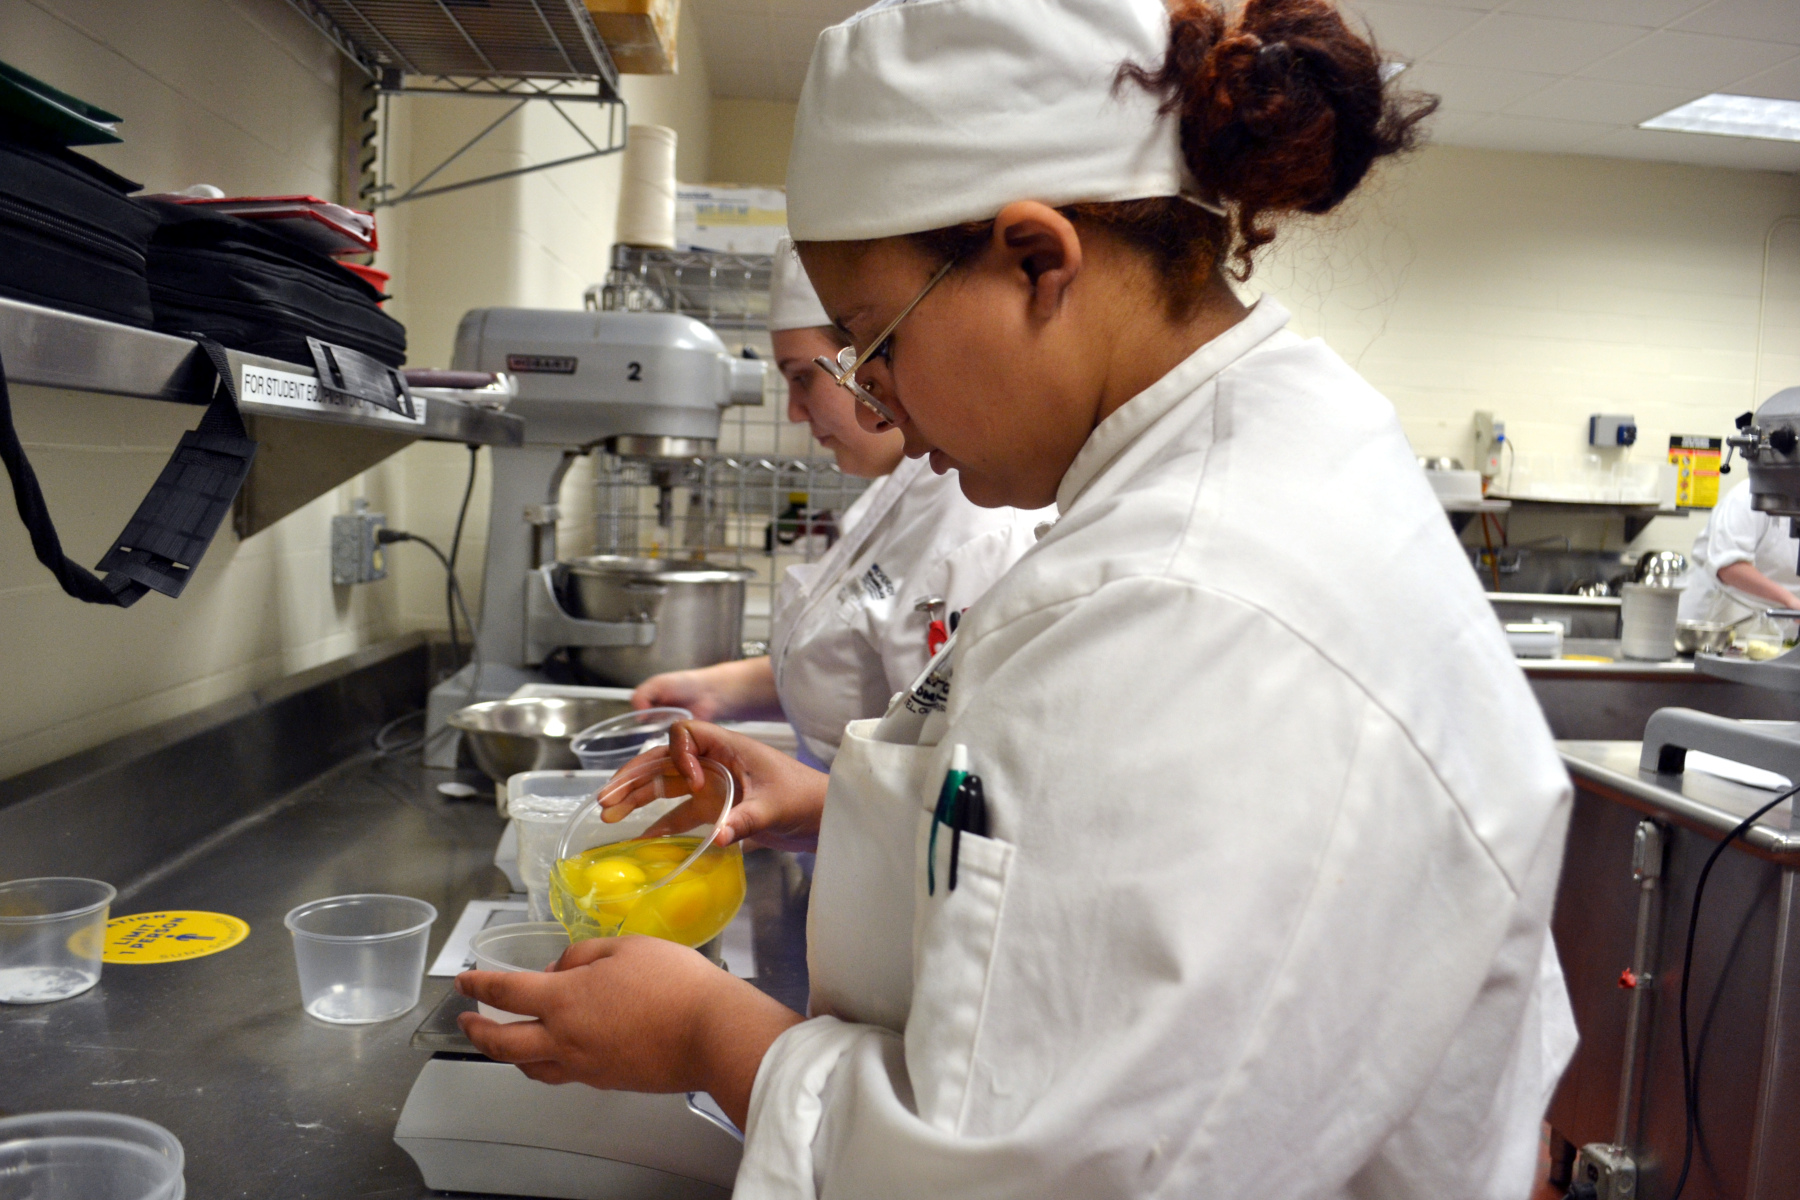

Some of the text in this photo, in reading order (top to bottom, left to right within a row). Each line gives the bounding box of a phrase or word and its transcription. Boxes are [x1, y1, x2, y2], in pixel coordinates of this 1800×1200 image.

[627, 361, 642, 381] 2
[244, 373, 264, 394] FOR
[266, 377, 305, 400] STUDENT
[113, 923, 155, 945] LIMIT
[129, 917, 187, 949] PERSON
